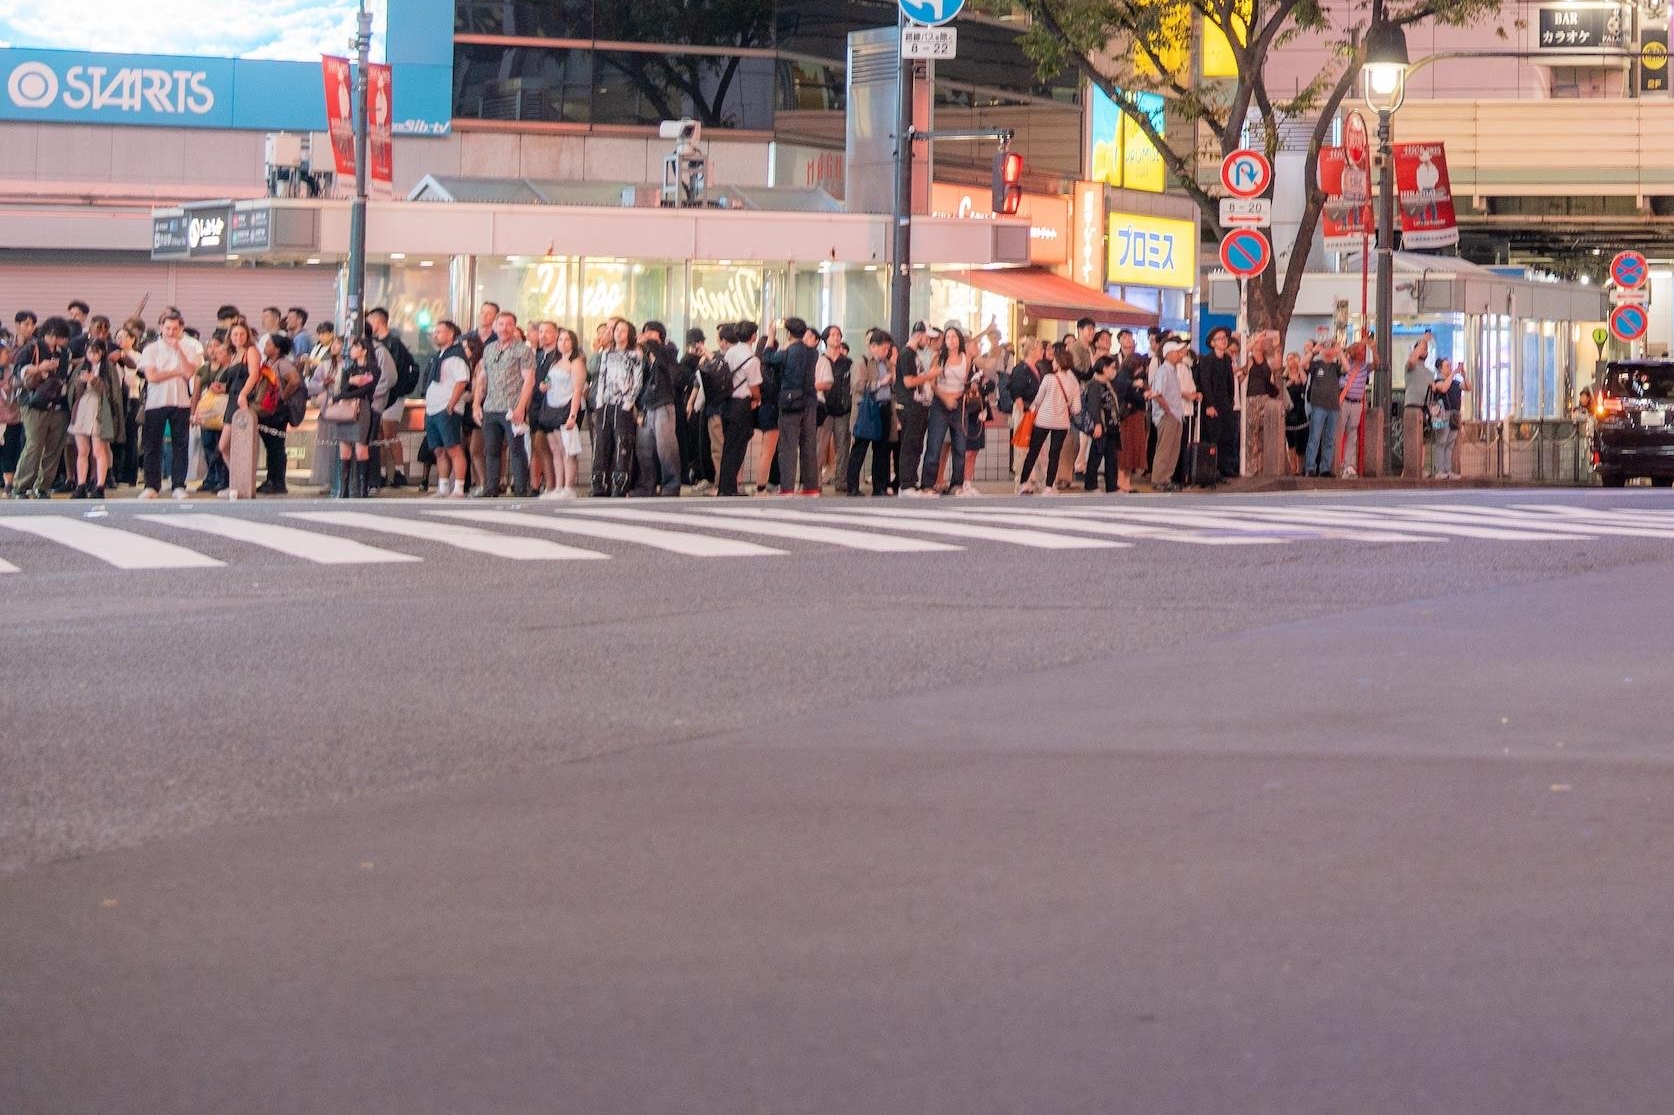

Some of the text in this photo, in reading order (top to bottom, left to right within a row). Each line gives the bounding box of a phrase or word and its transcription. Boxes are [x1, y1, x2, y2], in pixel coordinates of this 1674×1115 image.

[1554, 12, 1578, 25] BAR
[904, 31, 953, 43] 路線バスを除く
[1542, 31, 1591, 44] カラオケ
[63, 65, 215, 114] STARTS
[1118, 225, 1174, 271] プロミス
